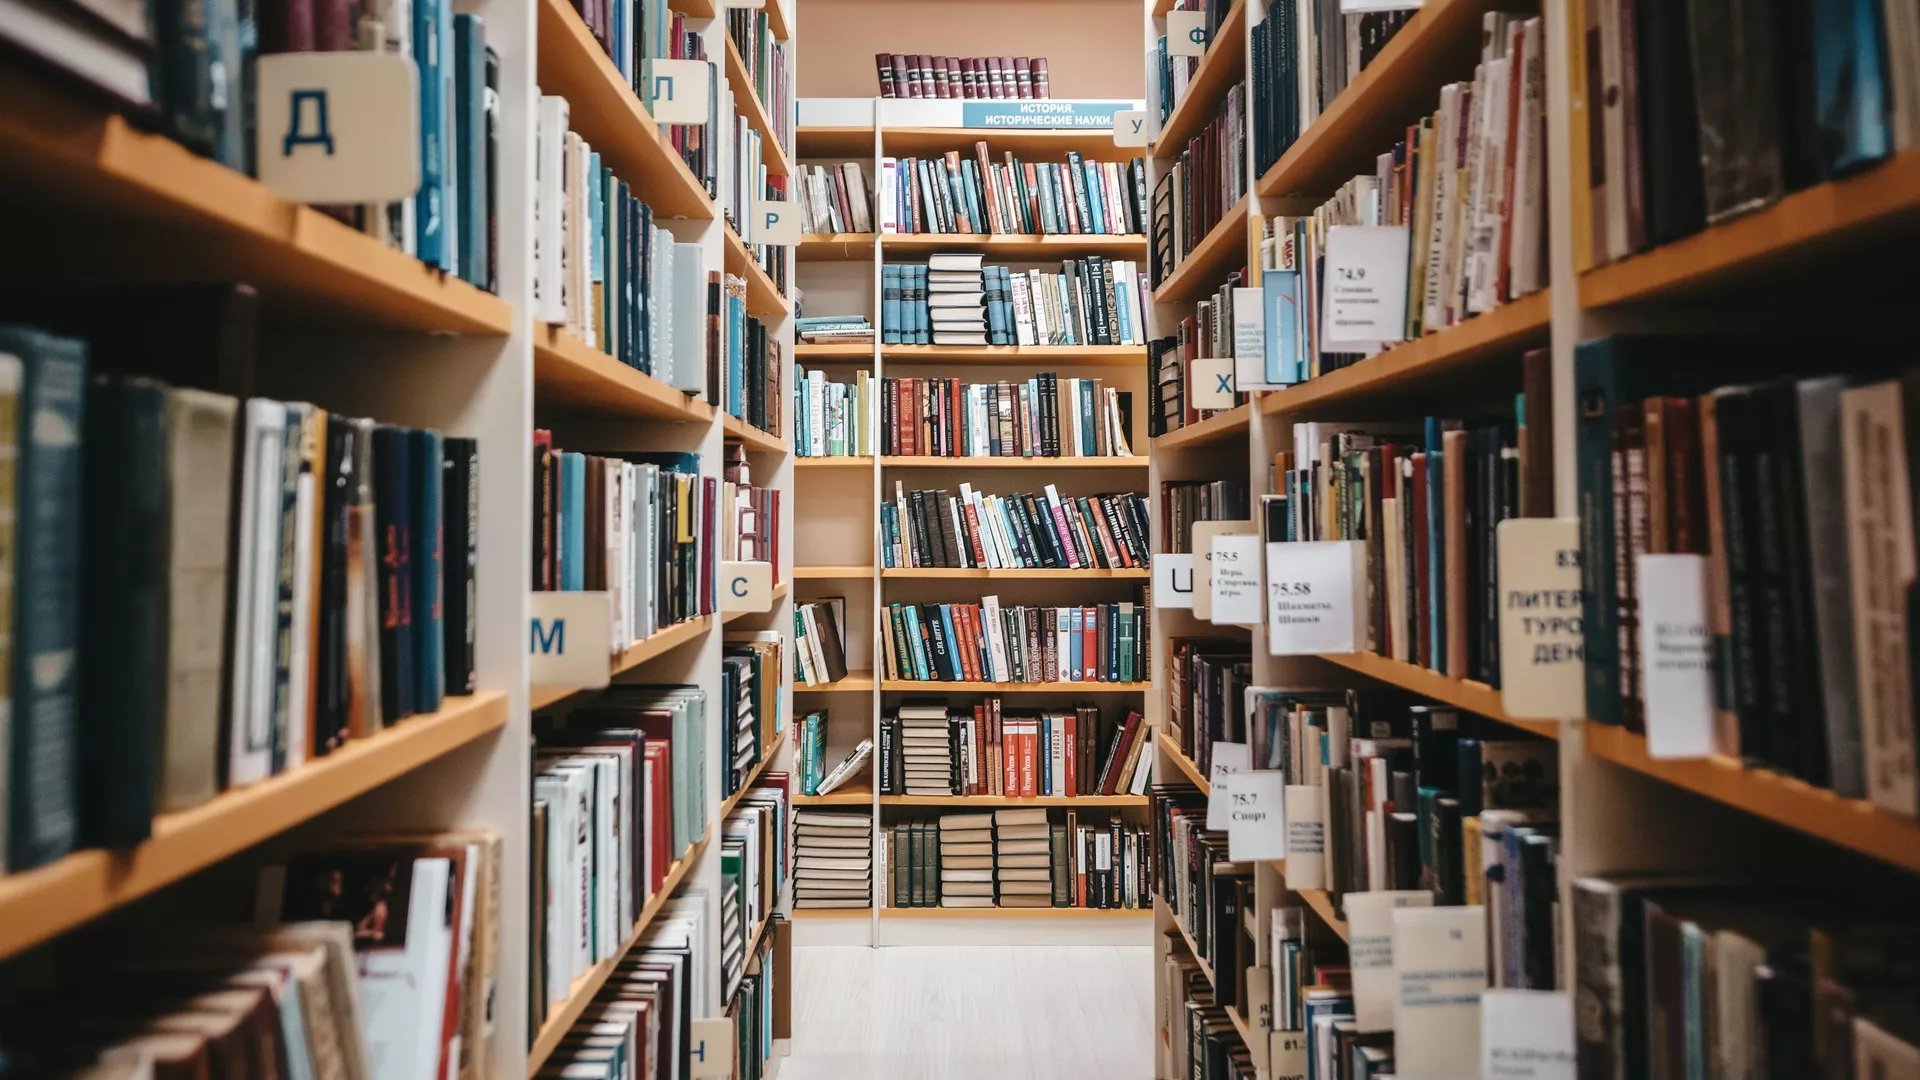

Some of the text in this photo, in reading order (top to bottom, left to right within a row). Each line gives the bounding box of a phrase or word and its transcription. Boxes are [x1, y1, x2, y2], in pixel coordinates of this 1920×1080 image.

[1188, 27, 1205, 44] Ф
[652, 76, 673, 101] Л
[1020, 103, 1075, 113] ИСТОРИЯ.
[284, 89, 334, 158] Д
[985, 115, 1113, 125] ИСТОРИЧЕСКИЕ НАУКИ.
[1131, 119, 1143, 134] У
[766, 212, 779, 230] Р
[1216, 374, 1232, 394] Х
[966, 508, 983, 559] СРЕДНИЕ ВЕКА
[1054, 509, 1075, 561] НОВОЕ ВРЕМЯ
[1216, 552, 1239, 562] 75.5
[731, 577, 748, 597] С
[1271, 582, 1311, 596] 75.58
[530, 617, 565, 655] М
[1006, 755, 1015, 772] России
[1007, 772, 1017, 791] История
[1022, 755, 1033, 791] История России
[1232, 794, 1257, 806] 75.7
[1232, 812, 1266, 822] Спорт
